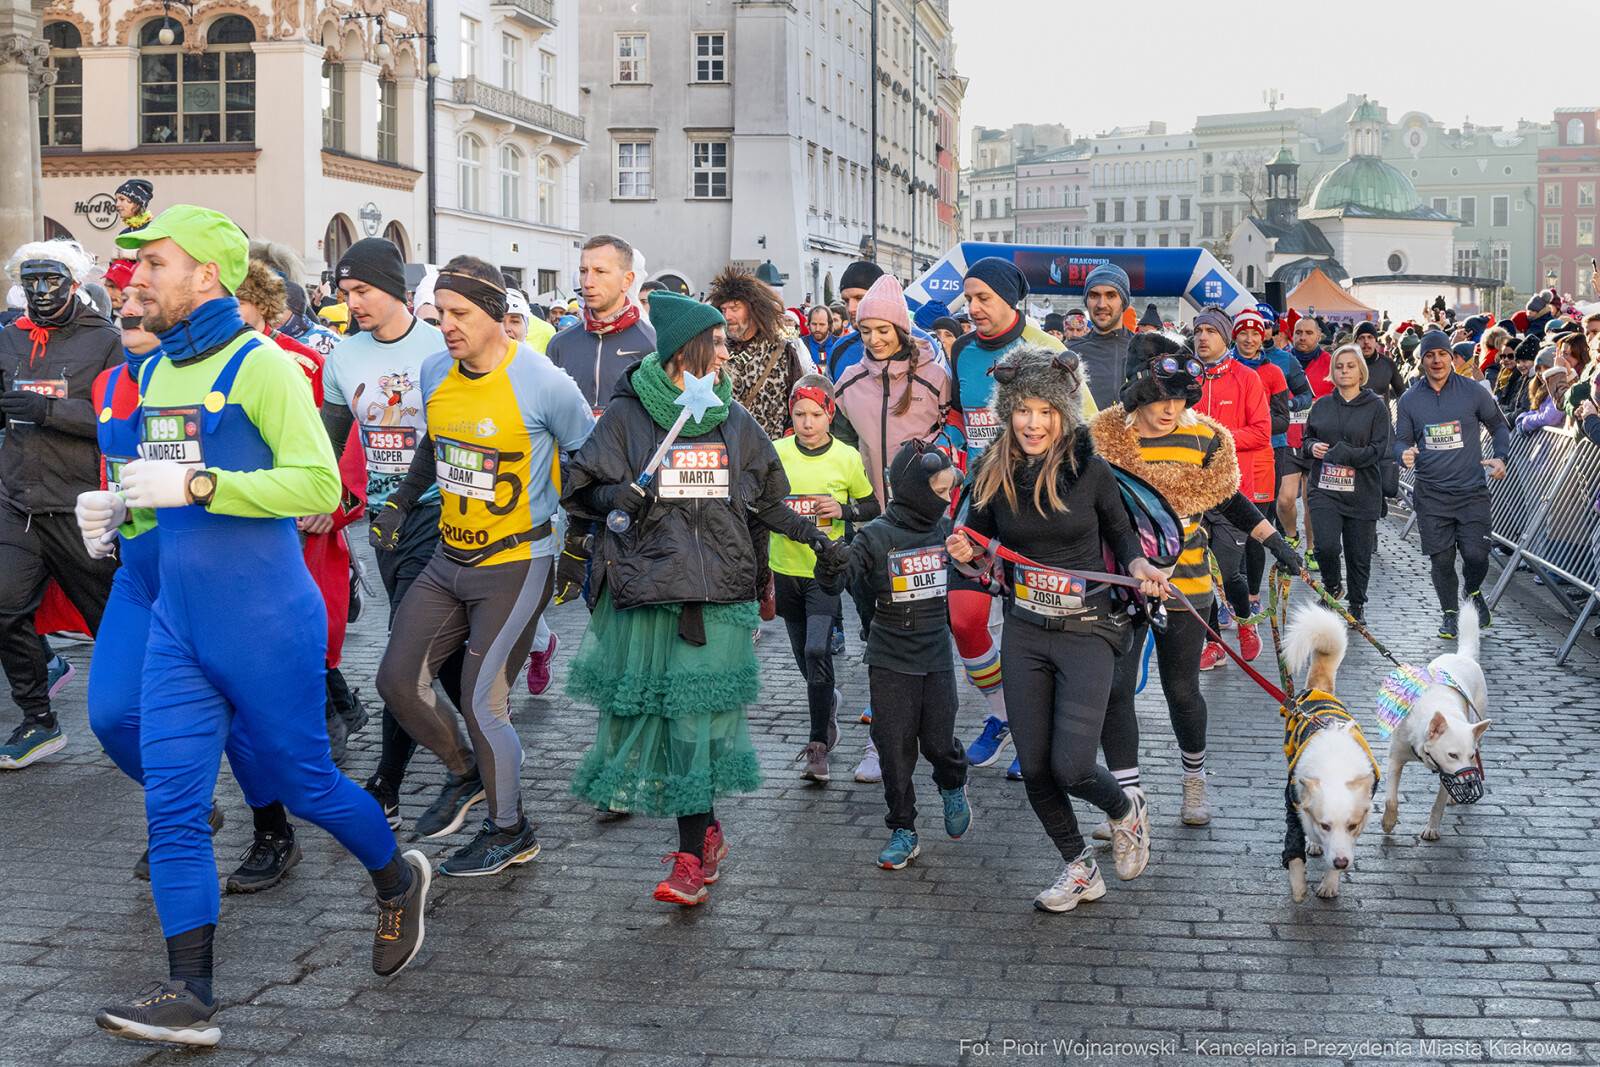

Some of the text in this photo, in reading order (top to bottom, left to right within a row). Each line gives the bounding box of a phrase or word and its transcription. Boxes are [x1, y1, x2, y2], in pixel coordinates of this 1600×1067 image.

[74, 200, 117, 215] Hard Ro
[1069, 257, 1109, 265] KRAKOWSKI
[941, 279, 960, 290] ZIS
[968, 412, 996, 425] 2603
[151, 418, 178, 439] 899
[1431, 425, 1453, 435] 1299
[370, 432, 403, 448] 2593
[148, 443, 186, 460] ANDRZEJ
[372, 449, 403, 462] KACPER
[449, 447, 478, 469] 1144
[675, 451, 719, 468] 2933
[448, 466, 474, 484] ADAM
[679, 470, 715, 484] MARTA
[1326, 466, 1347, 476] 3578
[1321, 474, 1352, 485] MAGDALENA
[903, 554, 941, 574] 3596
[913, 573, 936, 587] OLAF
[1027, 572, 1069, 593] 3597
[1033, 590, 1062, 607] ZOSIA
